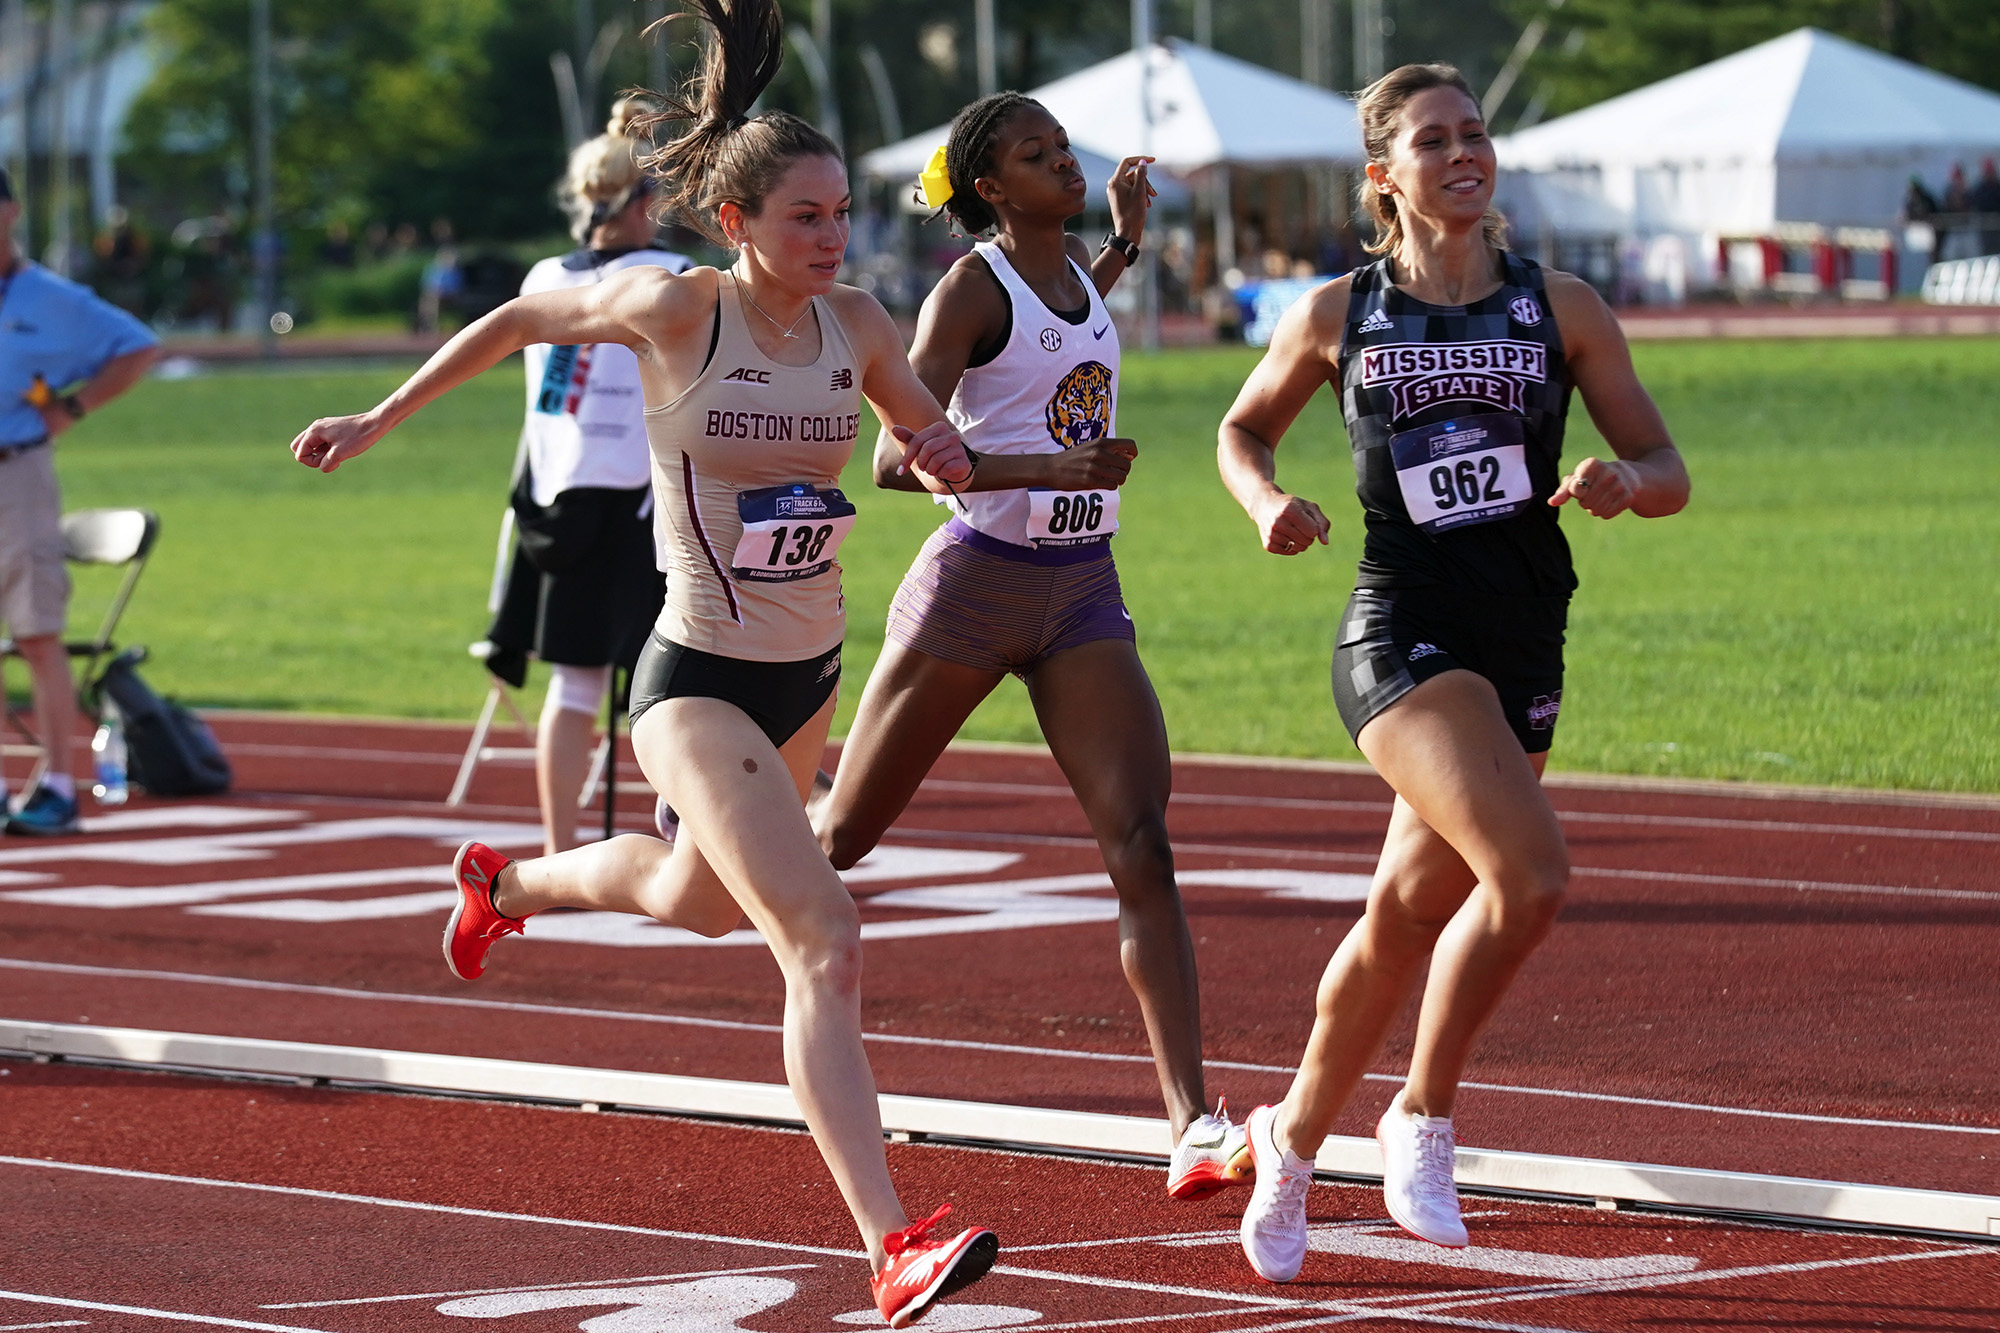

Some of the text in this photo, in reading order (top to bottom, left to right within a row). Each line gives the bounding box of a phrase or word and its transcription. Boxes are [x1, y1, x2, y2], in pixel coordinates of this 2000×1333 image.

[1041, 328, 1061, 351] SEC
[1358, 319, 1395, 334] adidas
[723, 367, 772, 384] ACC
[1364, 346, 1546, 379] MISSISSIPPI
[1414, 376, 1502, 404] STATE
[705, 409, 861, 442] BOSTON COLLEG
[1429, 455, 1506, 510] 962
[1048, 492, 1104, 534] 806
[767, 524, 834, 566] 138
